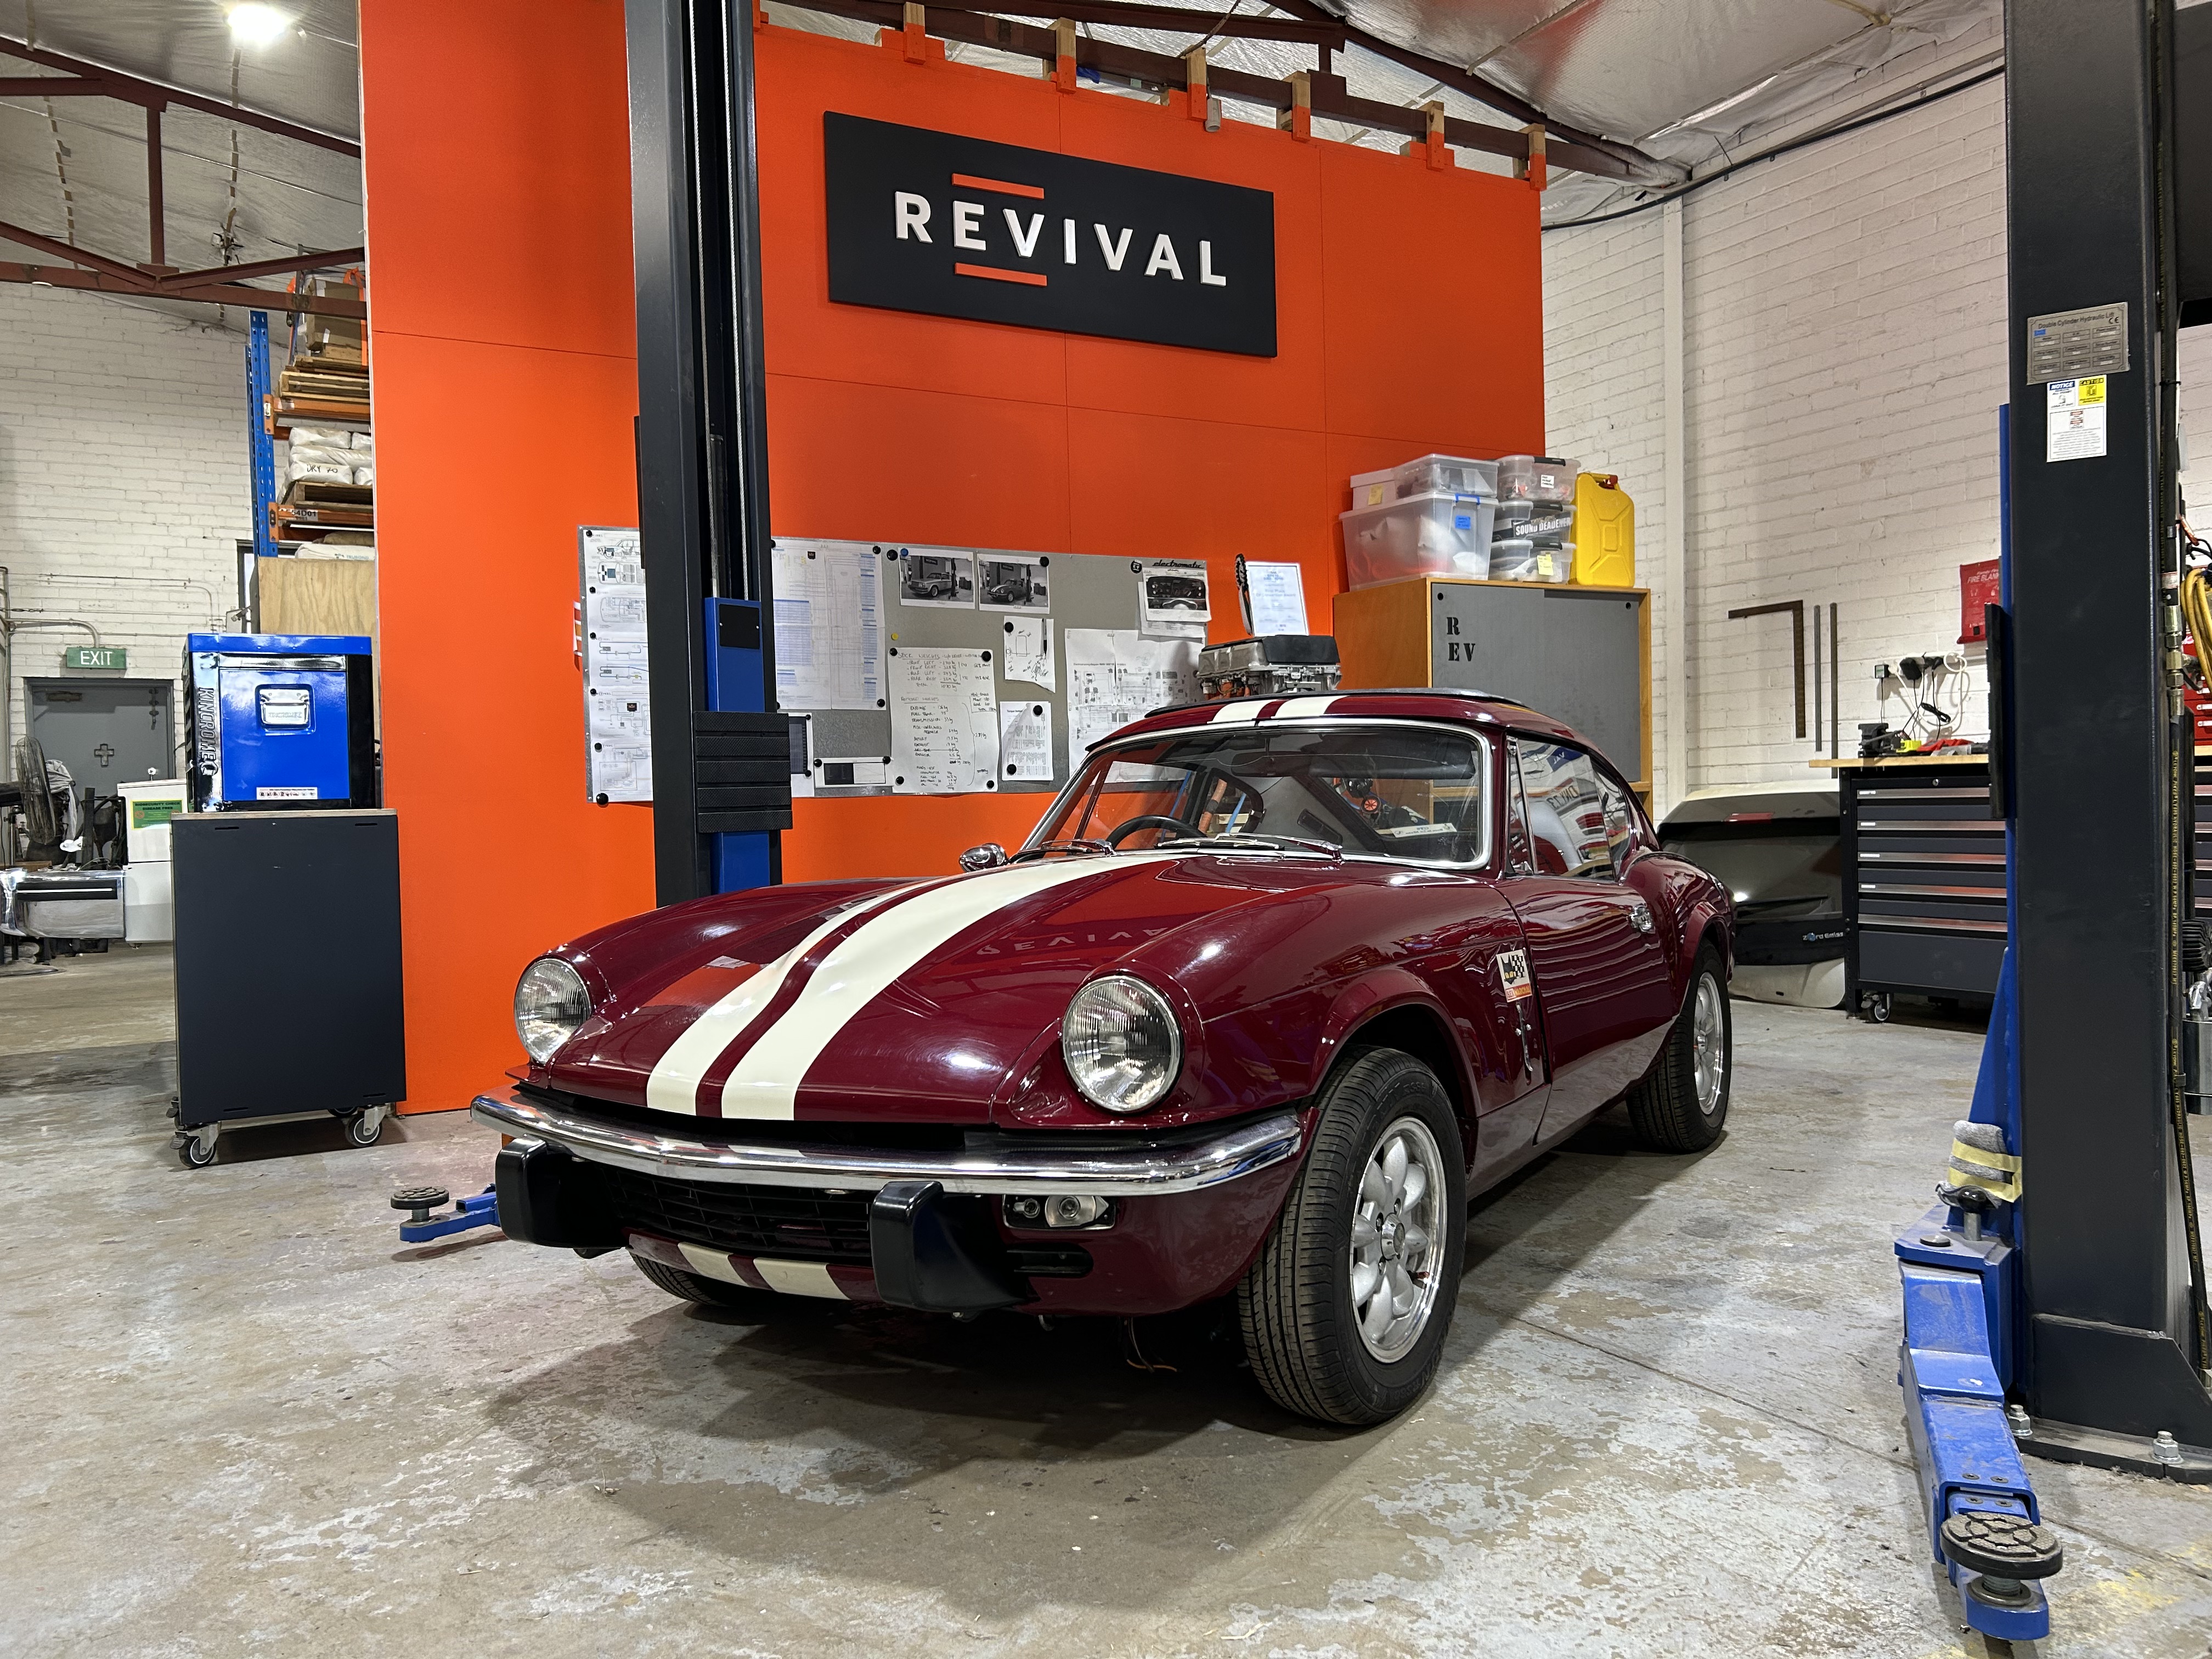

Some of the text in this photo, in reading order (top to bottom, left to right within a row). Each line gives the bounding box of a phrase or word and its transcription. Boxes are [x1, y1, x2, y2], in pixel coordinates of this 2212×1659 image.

[895, 191, 1227, 286] REVIVAL
[2038, 321, 2057, 329] Double
[2057, 318, 2080, 327] Cylinder
[2080, 313, 2105, 323] Hydraulic
[1515, 522, 1538, 535] SOUND
[1967, 575, 1981, 584] FIRE
[1446, 617, 1460, 635] R
[80, 651, 113, 665] EXIT
[198, 687, 217, 762] KINCROME
